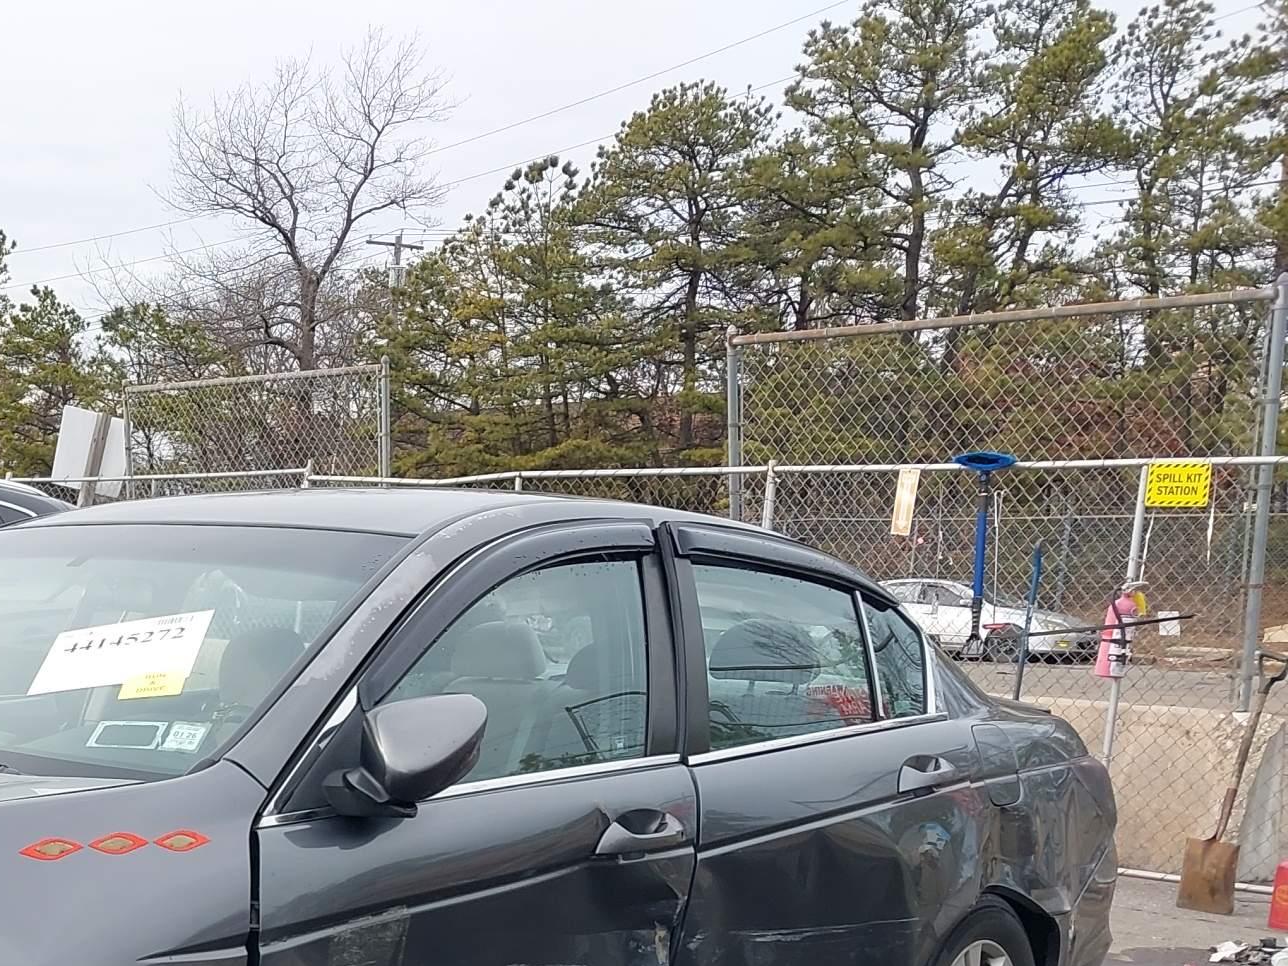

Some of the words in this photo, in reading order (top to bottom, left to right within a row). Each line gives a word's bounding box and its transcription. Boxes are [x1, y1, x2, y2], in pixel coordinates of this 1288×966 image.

[1156, 473, 1183, 483] SPILL
[1186, 473, 1203, 483] KIT
[1157, 485, 1199, 496] STATION
[64, 627, 185, 653] 44145272
